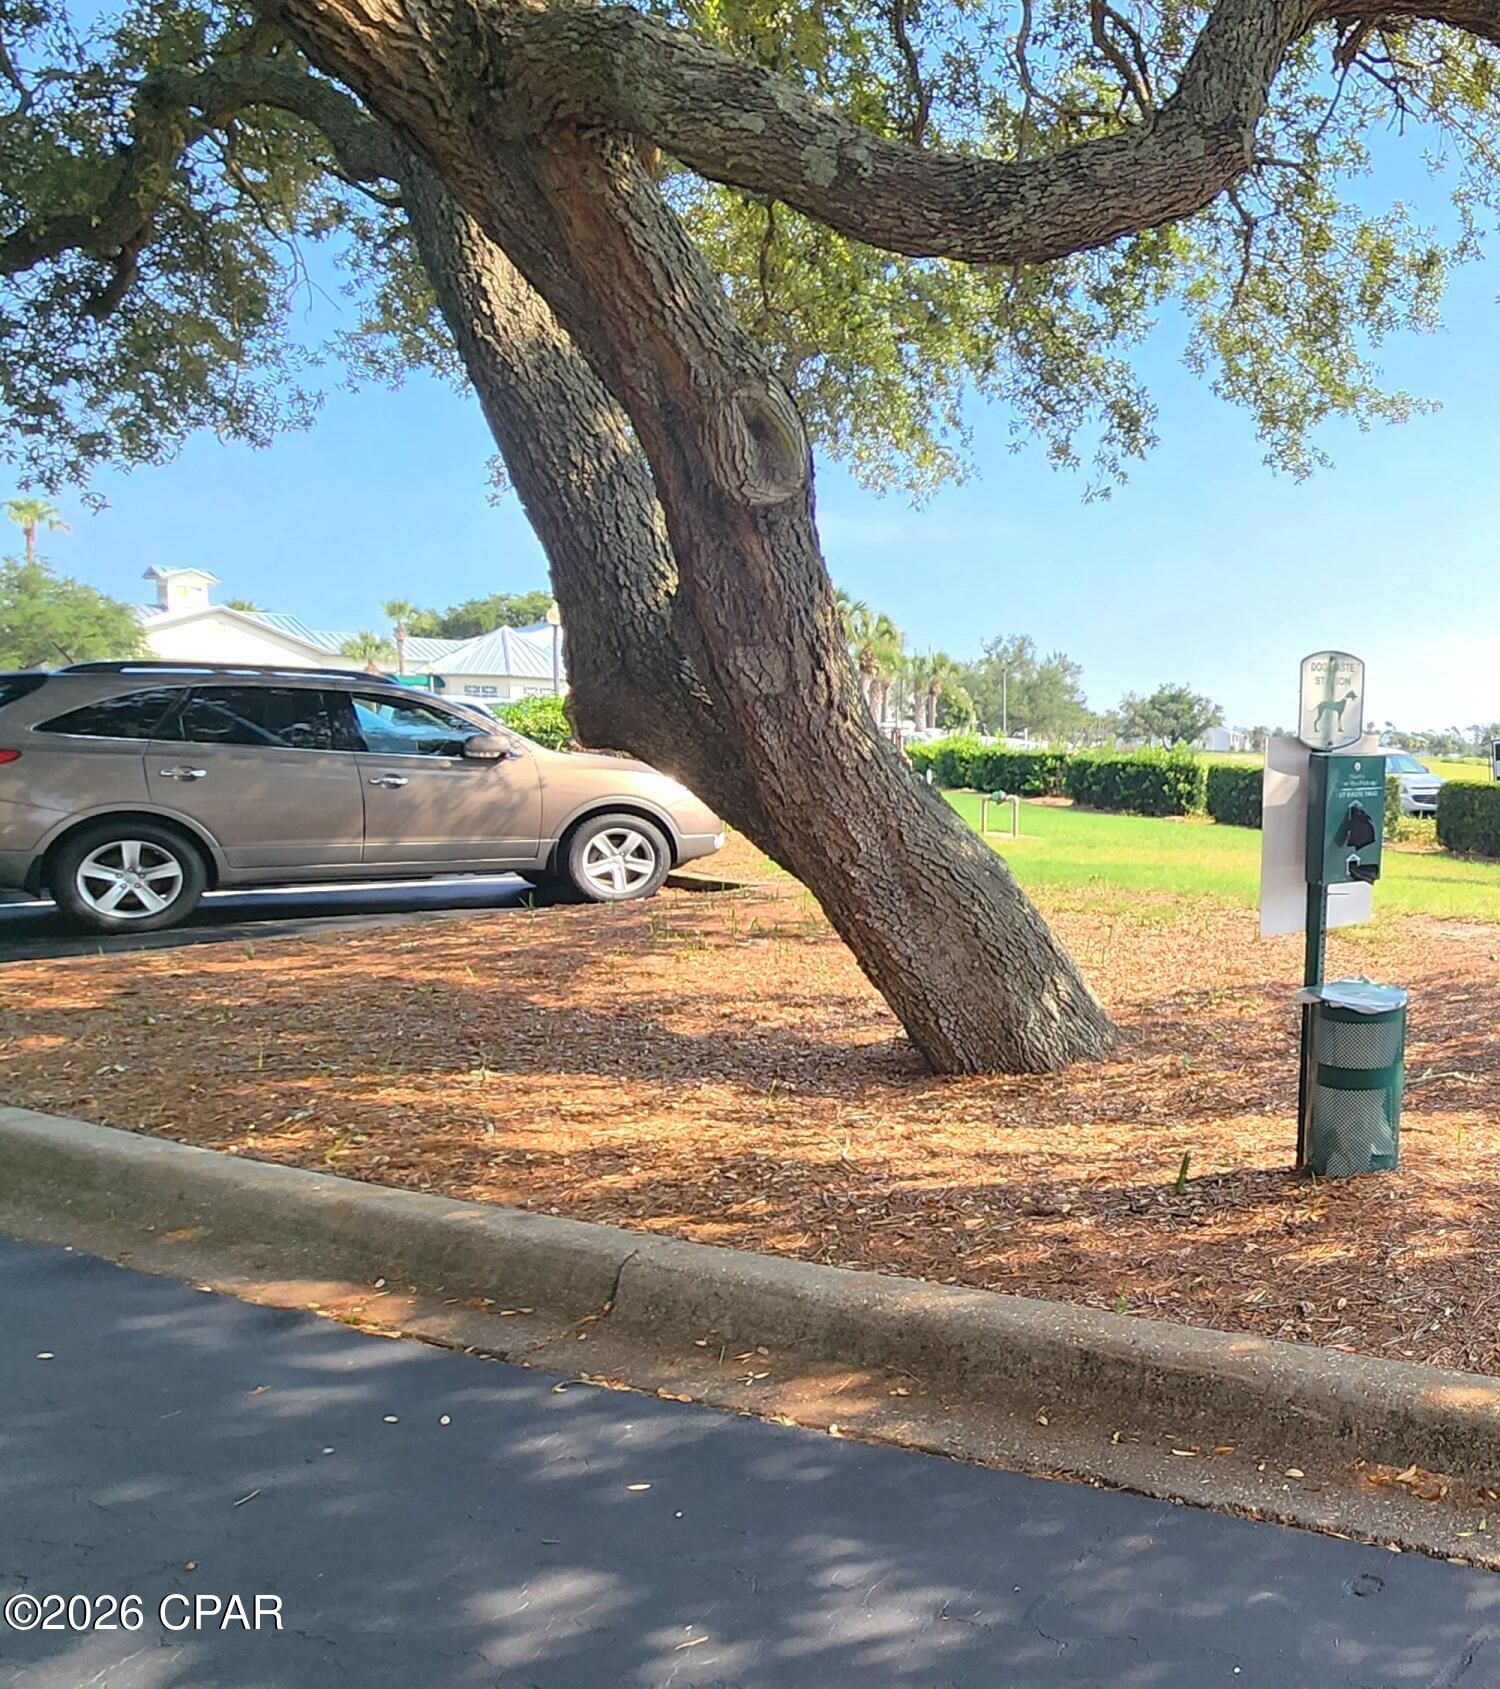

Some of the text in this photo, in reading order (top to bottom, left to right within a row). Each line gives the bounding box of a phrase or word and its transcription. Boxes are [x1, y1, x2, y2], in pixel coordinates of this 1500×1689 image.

[1311, 662, 1355, 673] DOG ASTE
[1315, 676, 1351, 686] STION
